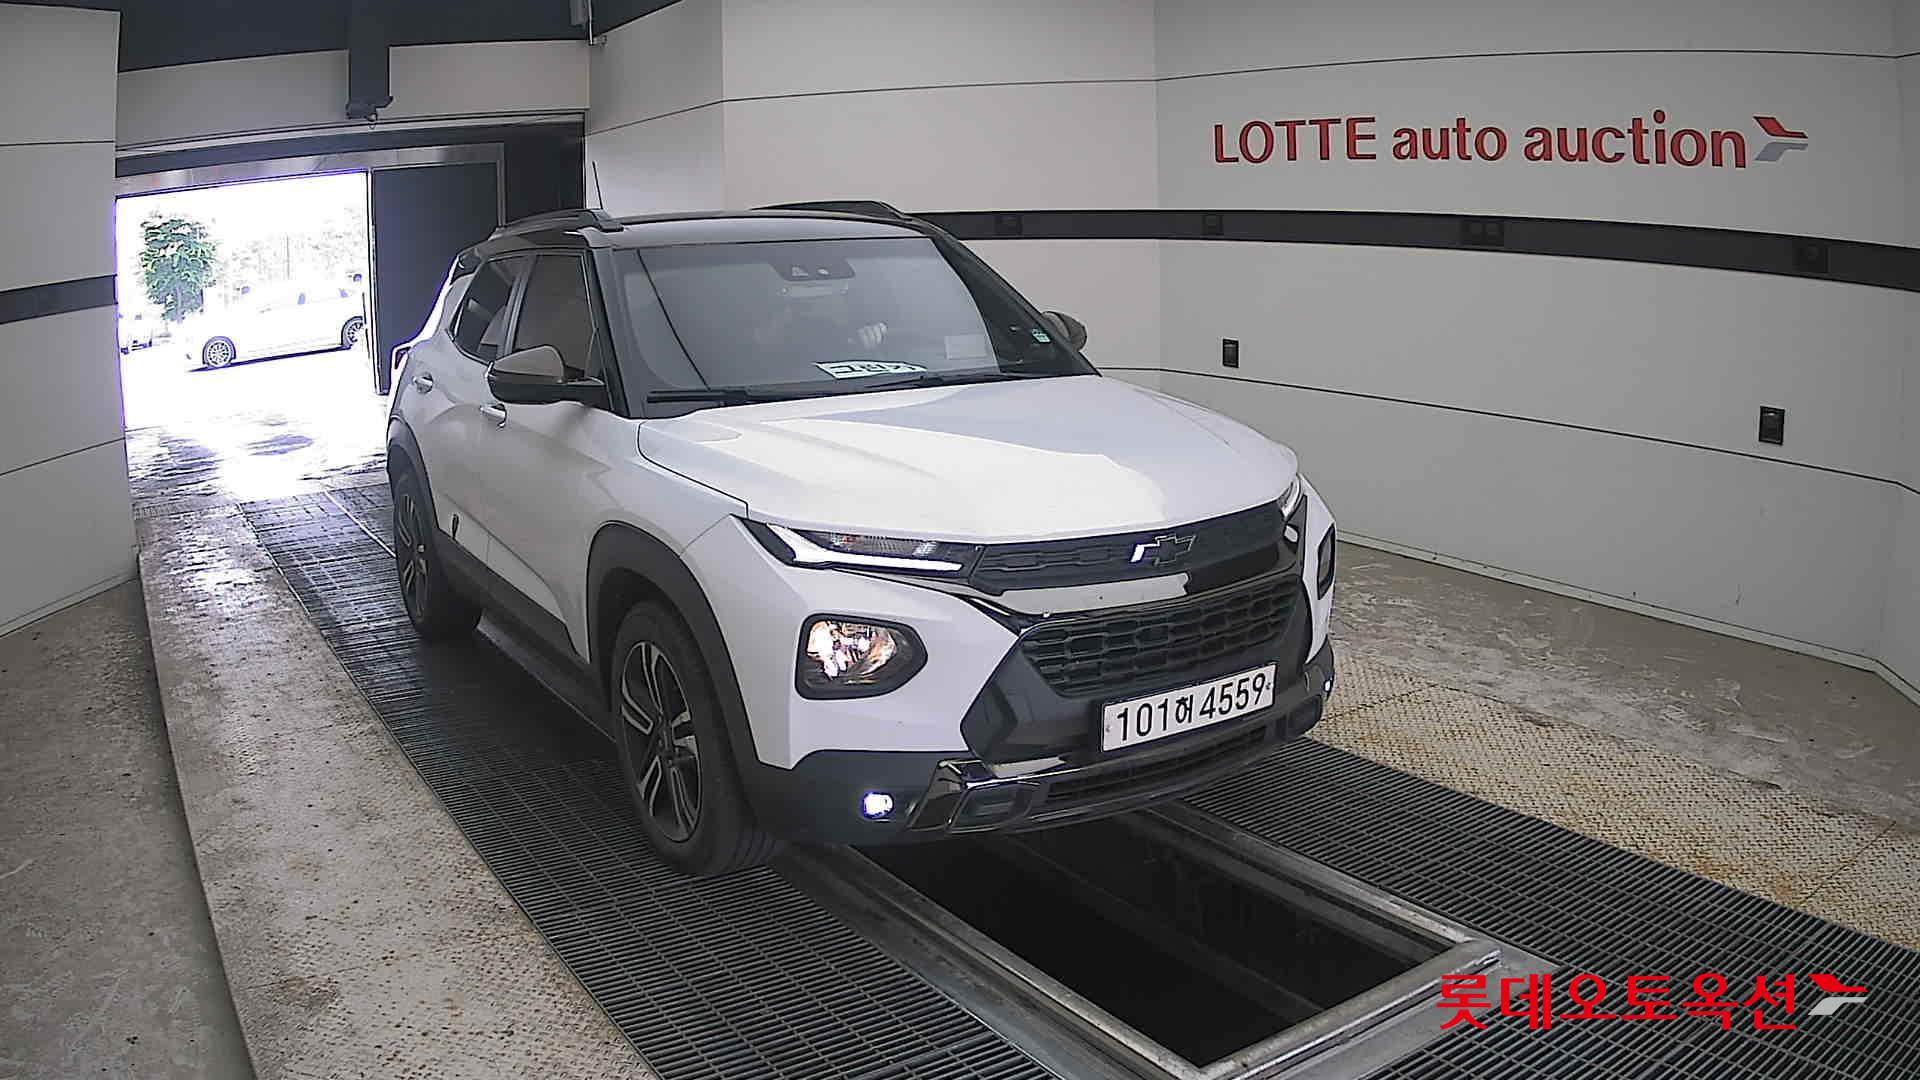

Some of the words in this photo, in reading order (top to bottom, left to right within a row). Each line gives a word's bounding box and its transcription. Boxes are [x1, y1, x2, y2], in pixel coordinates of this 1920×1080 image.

[1214, 117, 1377, 163] LOTTE
[1392, 118, 1509, 161] auto
[1523, 110, 1748, 168] auction
[1200, 672, 1266, 719] 4559
